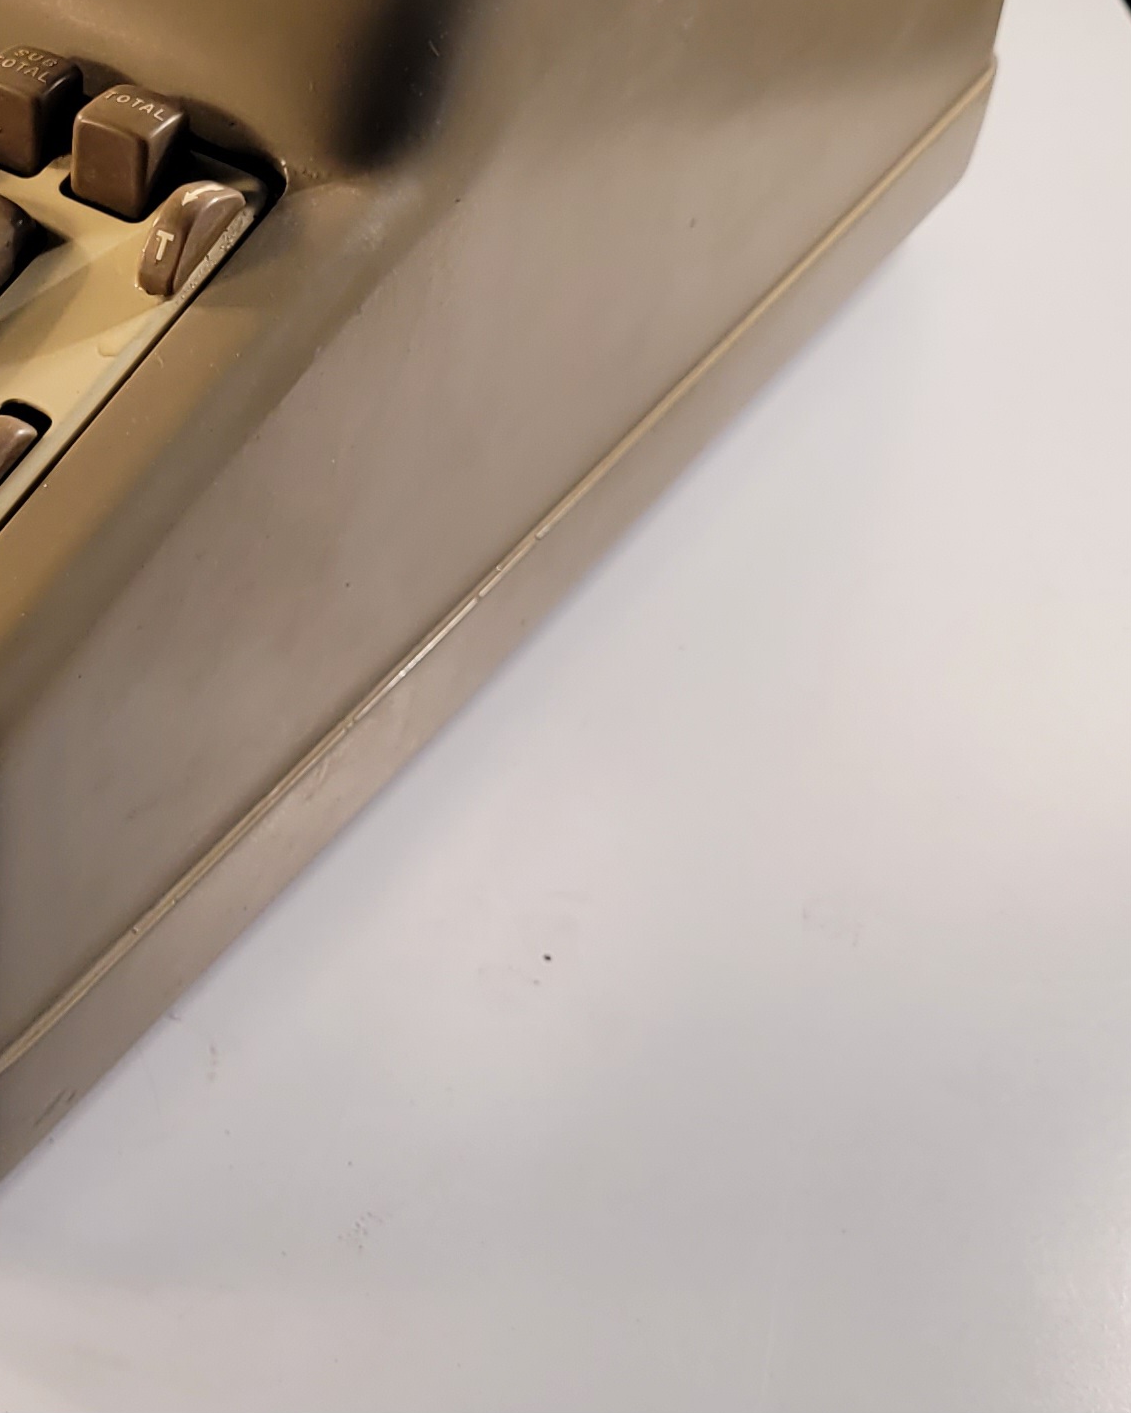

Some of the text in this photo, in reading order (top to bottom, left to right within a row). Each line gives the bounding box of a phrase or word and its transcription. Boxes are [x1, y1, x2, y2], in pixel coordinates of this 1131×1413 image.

[15, 49, 58, 67] SUB
[104, 91, 166, 121] TOTAL
[155, 229, 175, 261] T
